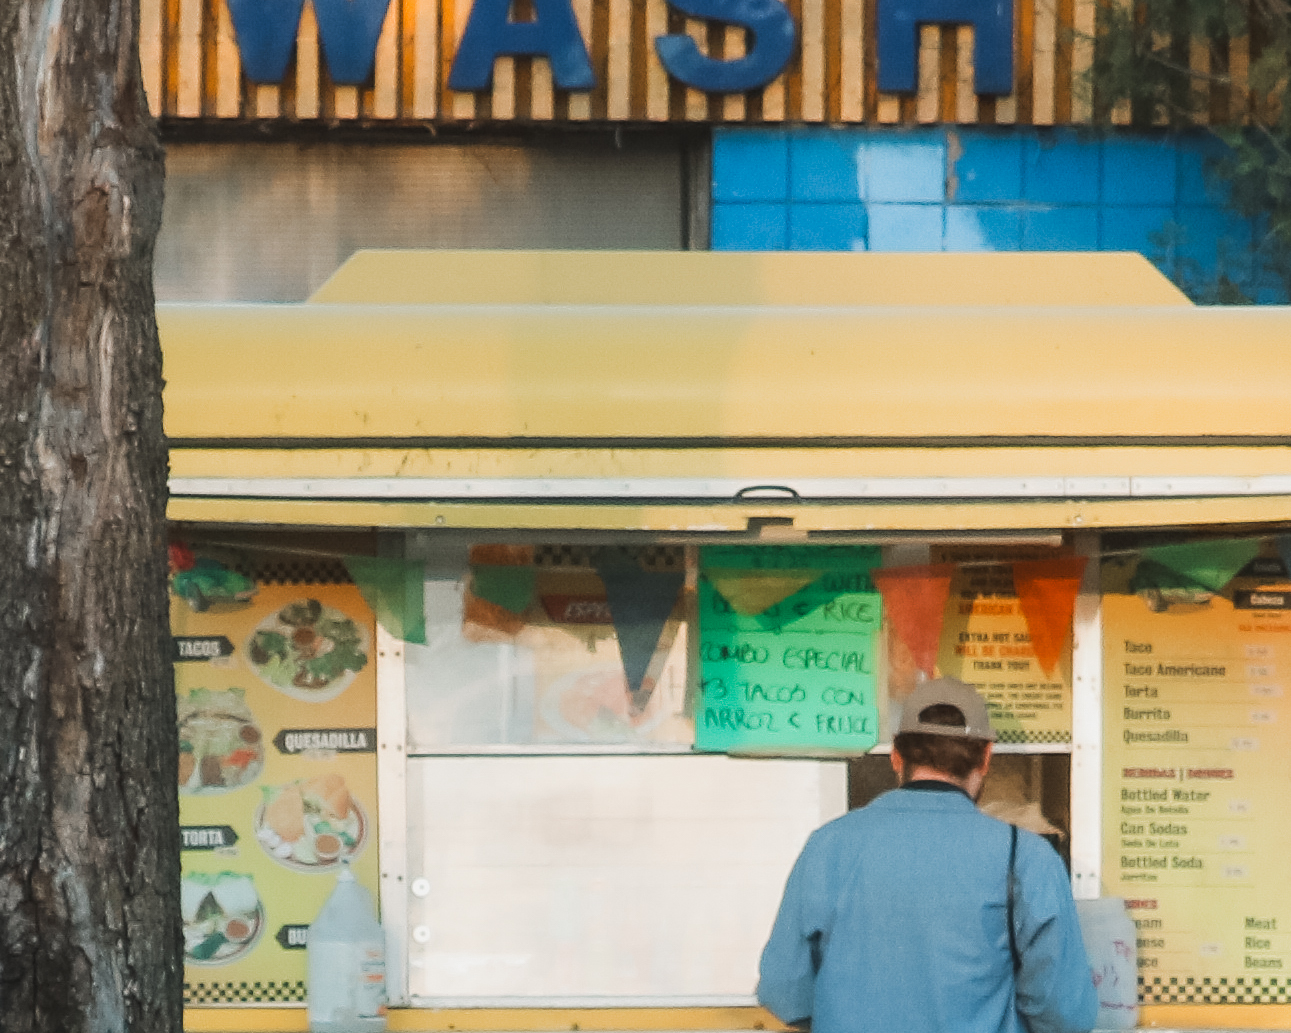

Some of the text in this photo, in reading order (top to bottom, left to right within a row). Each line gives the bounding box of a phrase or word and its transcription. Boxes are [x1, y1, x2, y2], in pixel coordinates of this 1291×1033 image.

[227, 0, 1014, 96] WASH
[823, 602, 875, 622] RICE
[177, 641, 220, 657] TACOS
[1124, 640, 1152, 653] Taco
[783, 646, 871, 675] ESPECIAL
[1124, 664, 1226, 676] Taco Americano
[737, 684, 806, 702] TACOS
[822, 687, 864, 705] CON
[1124, 685, 1158, 698] Torta
[1124, 707, 1170, 720] Burrito
[284, 733, 367, 752] QUESADILLA
[1124, 730, 1188, 743] Quesadilla
[1121, 788, 1210, 800] Bottled Water
[1121, 822, 1187, 834] Can Sodas
[181, 830, 224, 845] TORTA
[1121, 856, 1203, 868] Bottled Soda
[1134, 917, 1277, 930] eam Meat
[1244, 937, 1271, 949] Rice
